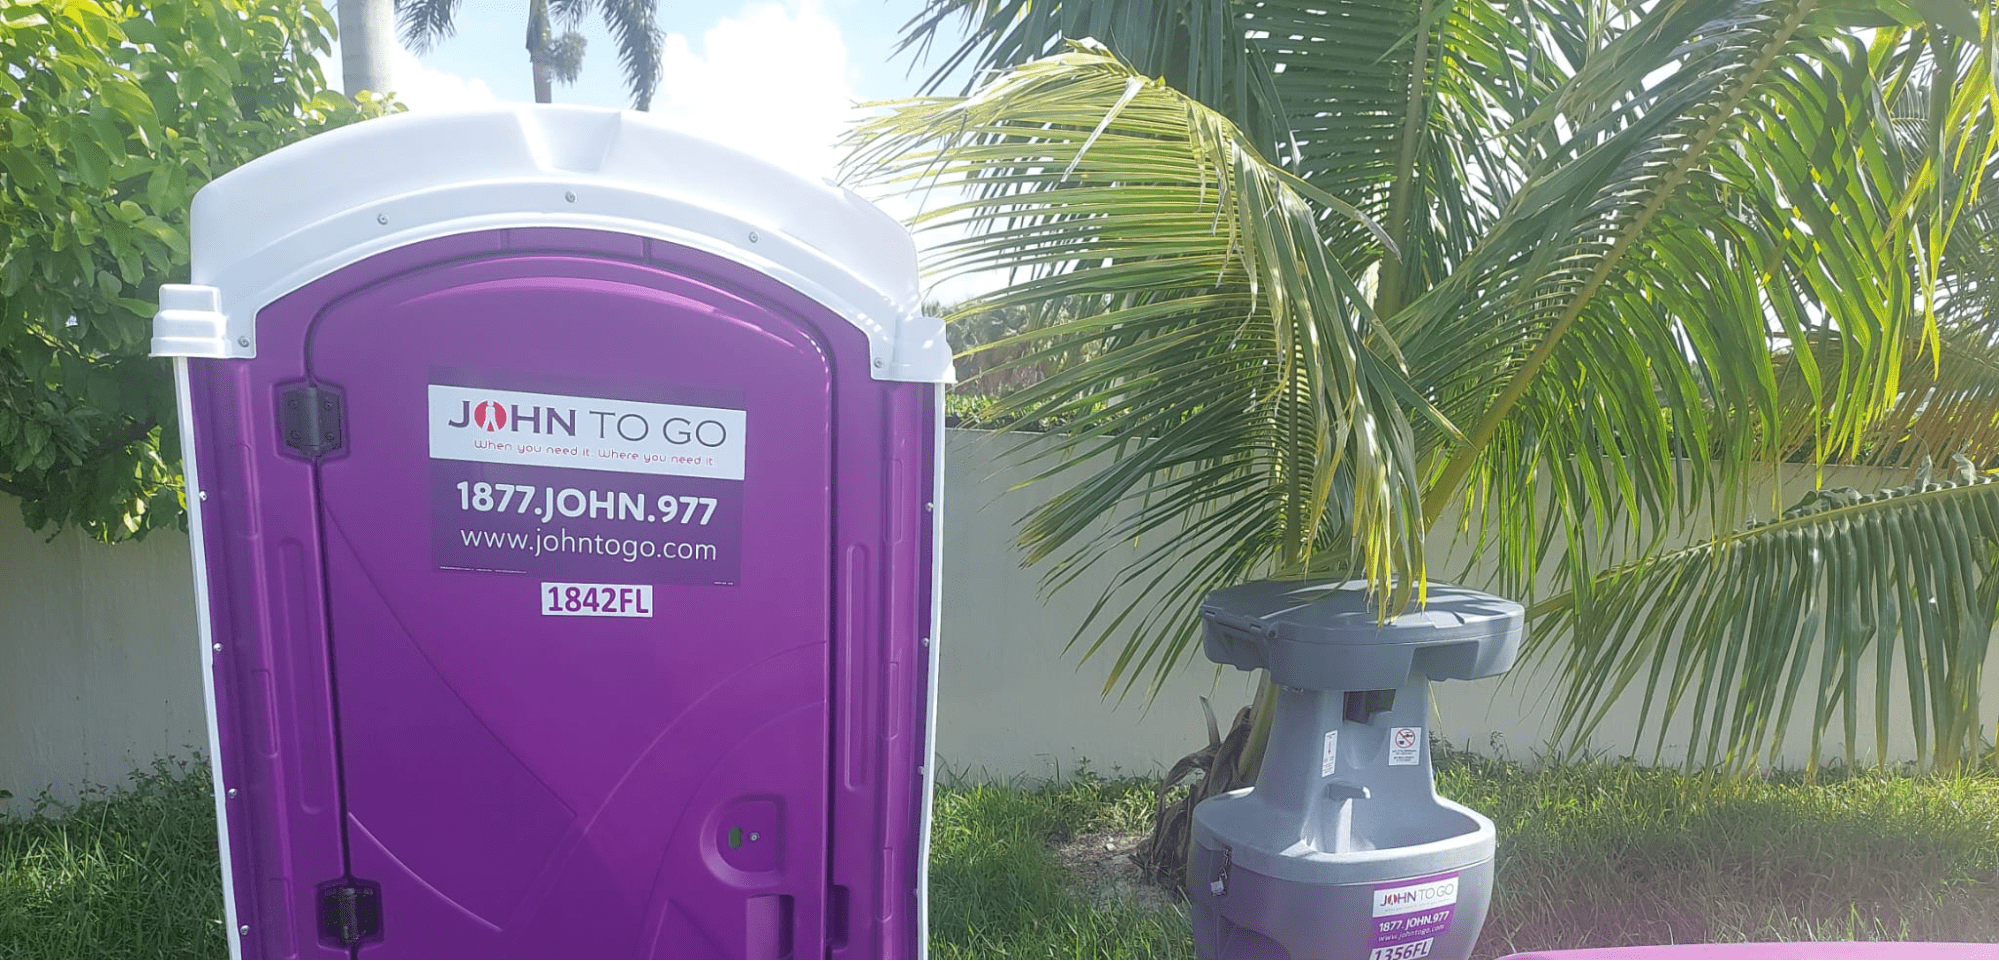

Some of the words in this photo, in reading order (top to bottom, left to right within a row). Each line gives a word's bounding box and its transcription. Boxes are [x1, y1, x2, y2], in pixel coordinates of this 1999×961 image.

[448, 400, 577, 437] JOHN
[589, 410, 649, 441] TO
[663, 417, 727, 447] GO
[474, 440, 512, 450] When
[517, 444, 542, 454] you
[546, 446, 578, 456] need
[598, 449, 639, 460] Where
[643, 454, 667, 463] you
[671, 456, 702, 465] need
[457, 481, 718, 525] 1877.JOHN.977
[460, 528, 717, 562] www.johntogo.com
[547, 586, 649, 614] 1842FL
[1380, 890, 1417, 907] JOHN
[1418, 887, 1436, 900] TO
[1436, 883, 1455, 897] GO
[1374, 941, 1428, 960] 1356FL
